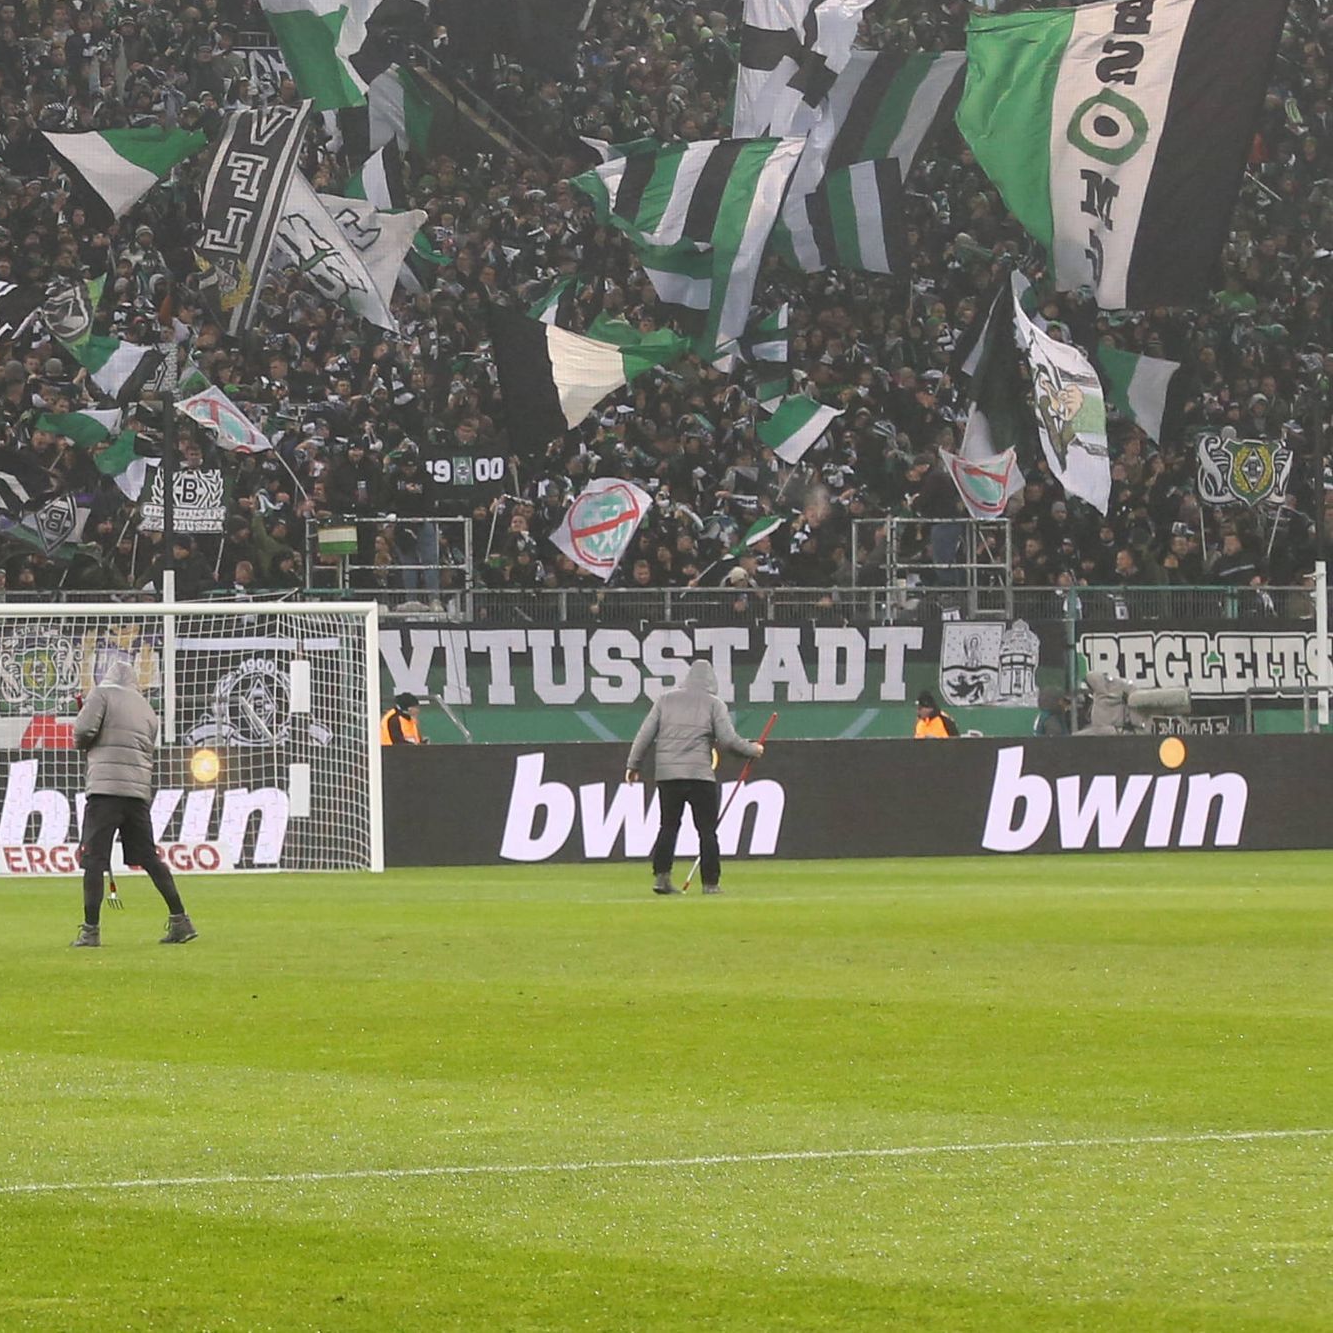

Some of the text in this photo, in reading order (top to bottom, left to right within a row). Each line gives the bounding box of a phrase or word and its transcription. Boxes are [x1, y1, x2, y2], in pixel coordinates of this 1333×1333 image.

[141, 502, 227, 520] GEEINSAM
[164, 519, 224, 533] ORUSSIA
[378, 625, 924, 707] VITUSSTADT
[981, 736, 1249, 853] bwin
[129, 844, 222, 872] RGO
